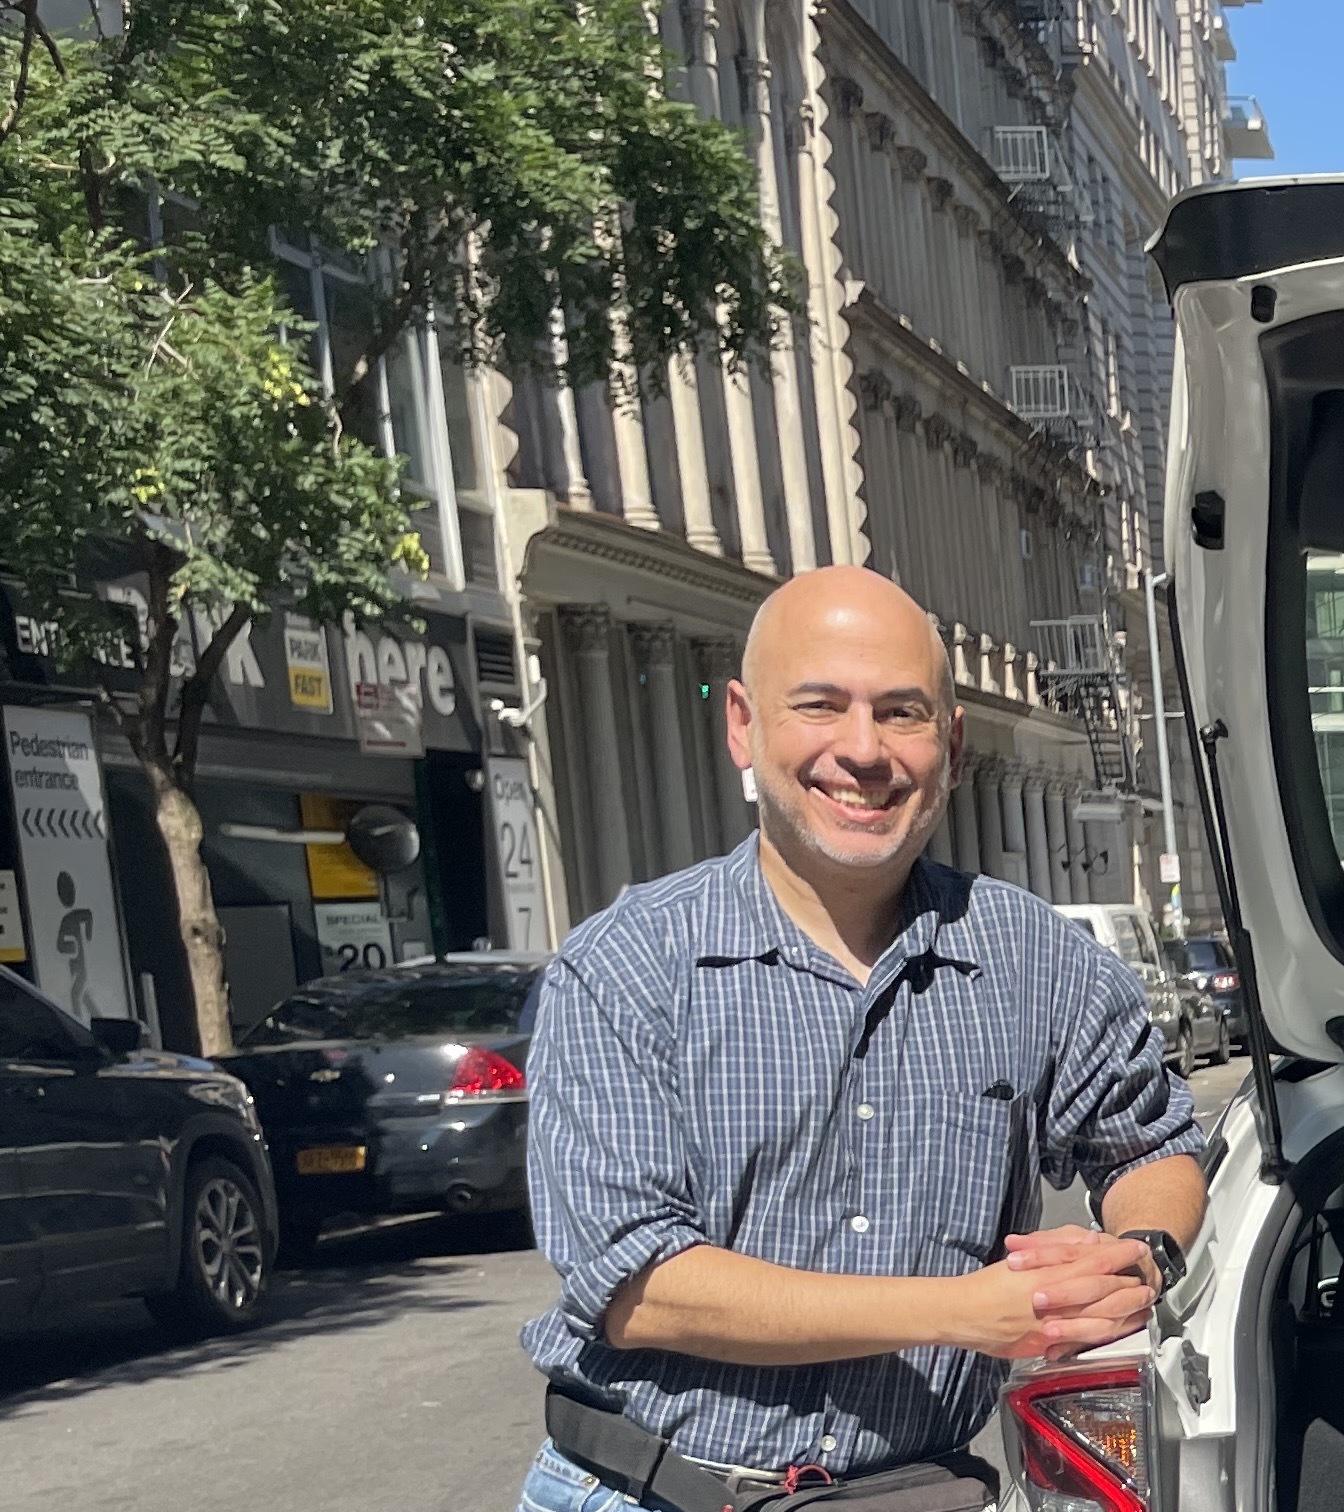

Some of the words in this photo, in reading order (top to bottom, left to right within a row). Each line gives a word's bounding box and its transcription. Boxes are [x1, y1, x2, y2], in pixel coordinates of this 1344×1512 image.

[342, 608, 456, 717] here
[294, 674, 322, 697] FAST
[10, 731, 88, 760] Pedestrian
[15, 766, 79, 790] entrance
[501, 822, 533, 878] 24
